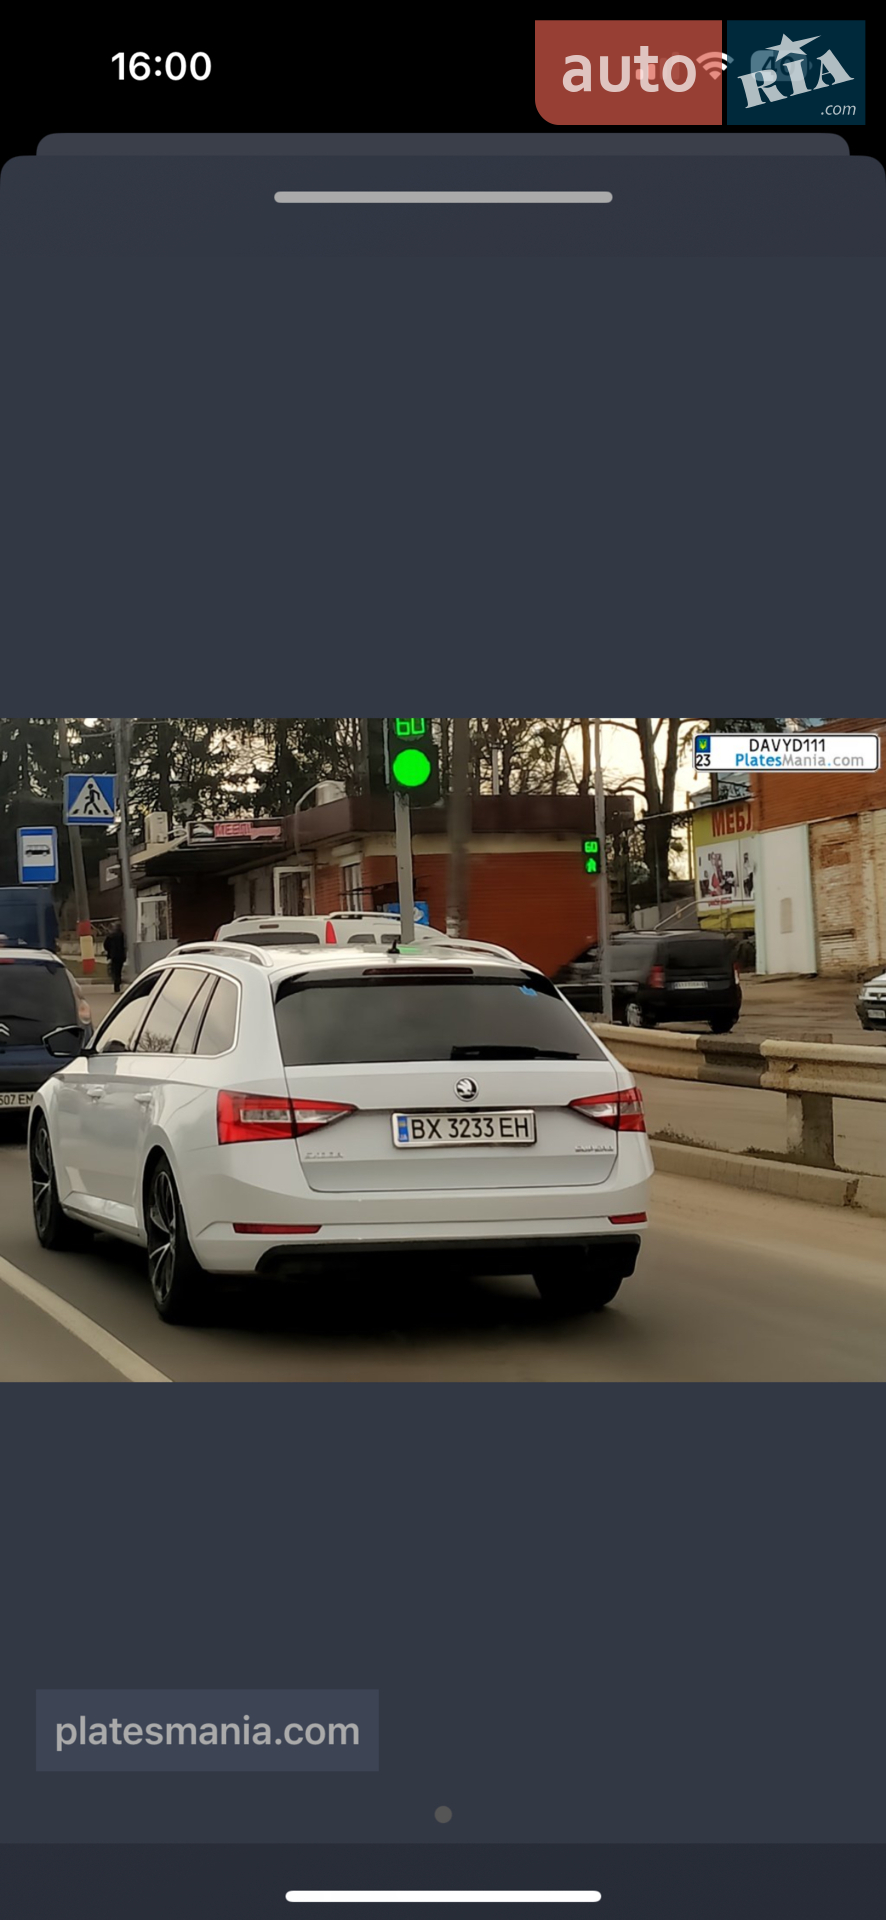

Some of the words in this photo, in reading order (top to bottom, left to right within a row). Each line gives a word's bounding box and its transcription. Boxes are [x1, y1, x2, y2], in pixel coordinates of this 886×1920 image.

[111, 51, 212, 81] 16:00
[411, 1118, 443, 1140] BX
[447, 1117, 495, 1138] 3233
[500, 1117, 529, 1138] EH
